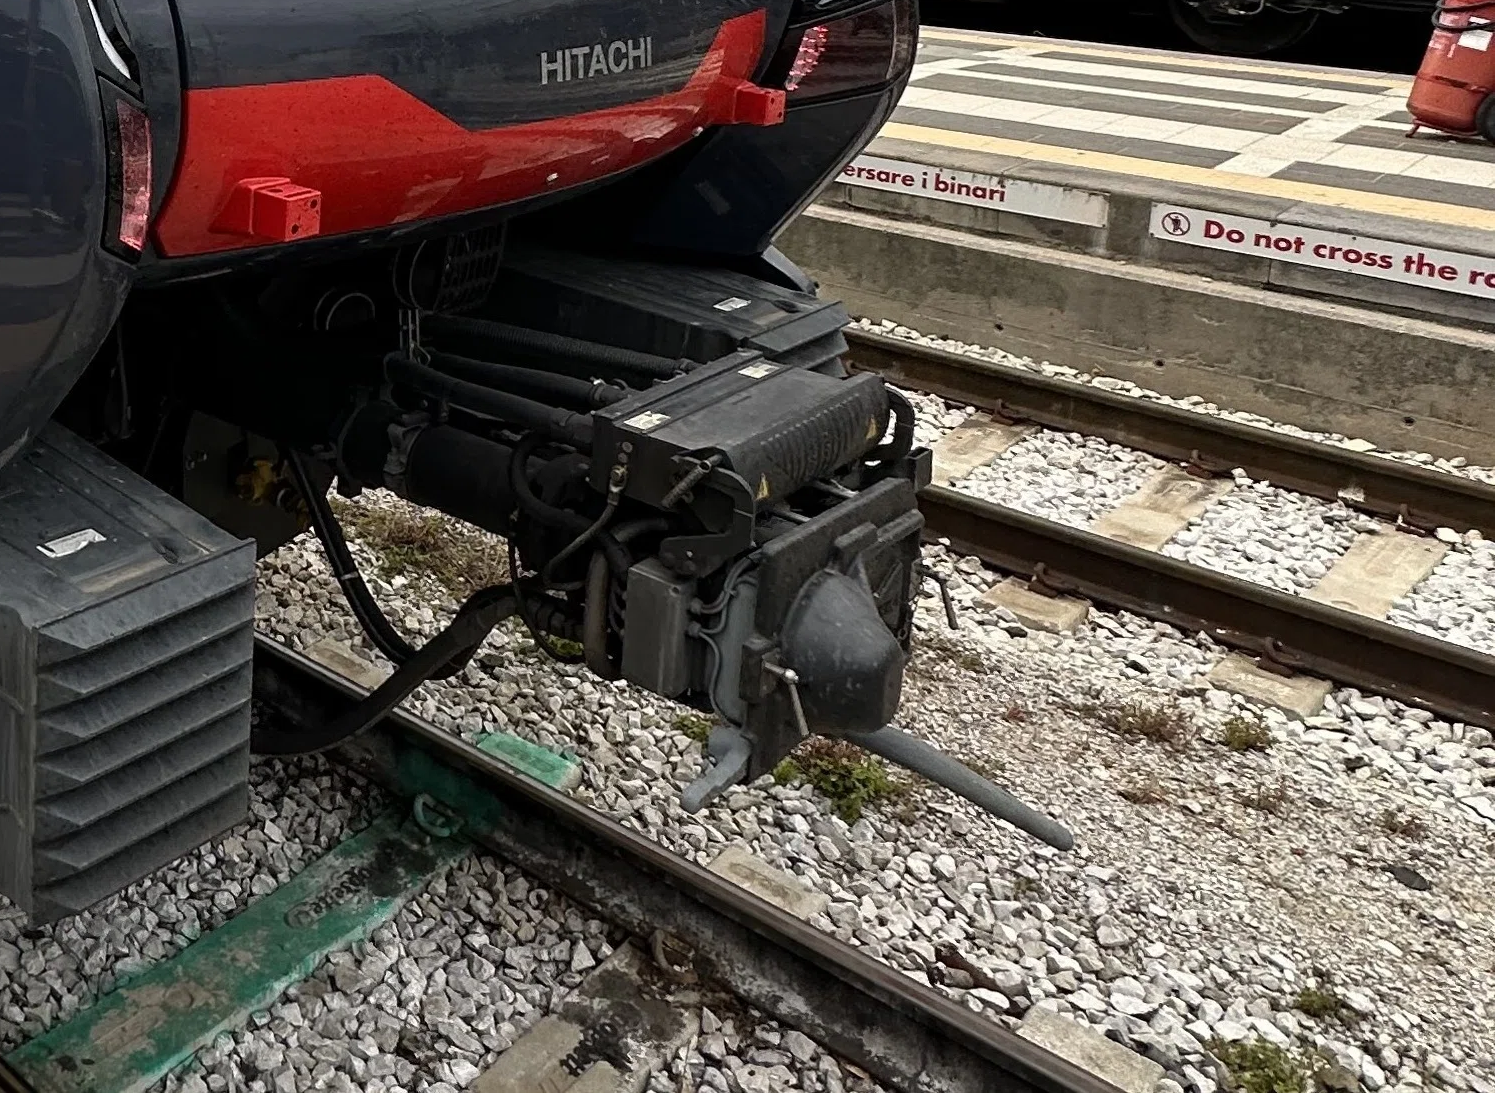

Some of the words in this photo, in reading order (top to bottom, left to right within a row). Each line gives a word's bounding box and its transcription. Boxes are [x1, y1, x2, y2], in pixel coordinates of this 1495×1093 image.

[540, 36, 652, 85] HITACHI
[922, 171, 928, 189] i
[934, 173, 1006, 202] binari
[1204, 219, 1245, 243] Do
[1253, 233, 1305, 254] not
[1313, 244, 1393, 270] cross
[1403, 252, 1458, 281] the
